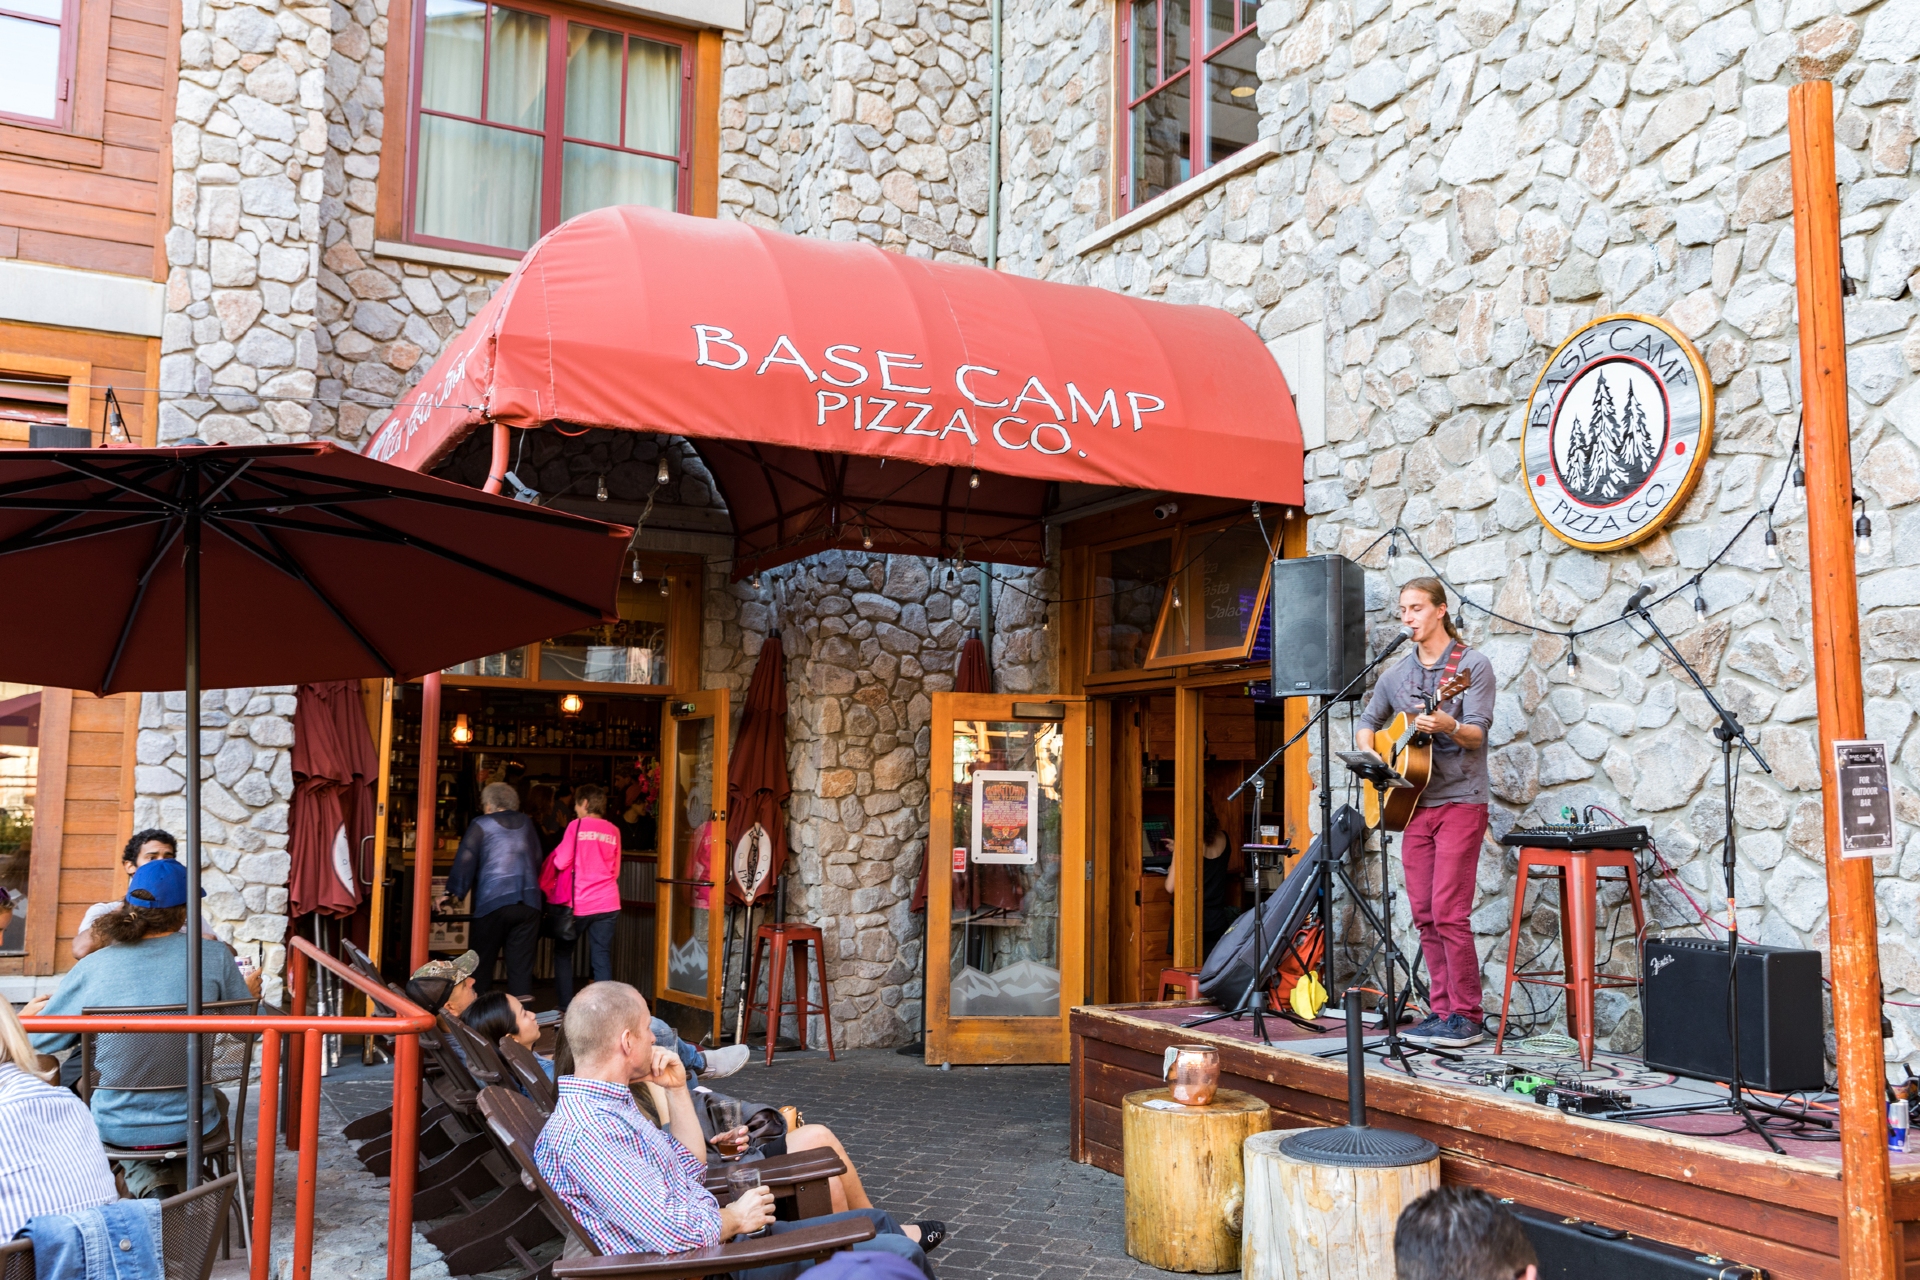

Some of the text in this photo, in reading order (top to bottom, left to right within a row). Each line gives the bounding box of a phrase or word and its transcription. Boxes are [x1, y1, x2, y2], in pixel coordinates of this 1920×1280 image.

[691, 323, 1166, 432] BASE CAMP
[1532, 326, 1688, 429] BASE CAMP
[816, 390, 1088, 459] PIZZA CO.
[1552, 483, 1670, 534] PIZZA CO.
[1852, 787, 1878, 796] OUTDOOR
[1858, 776, 1870, 784] FOR
[1859, 799, 1872, 807] BAR
